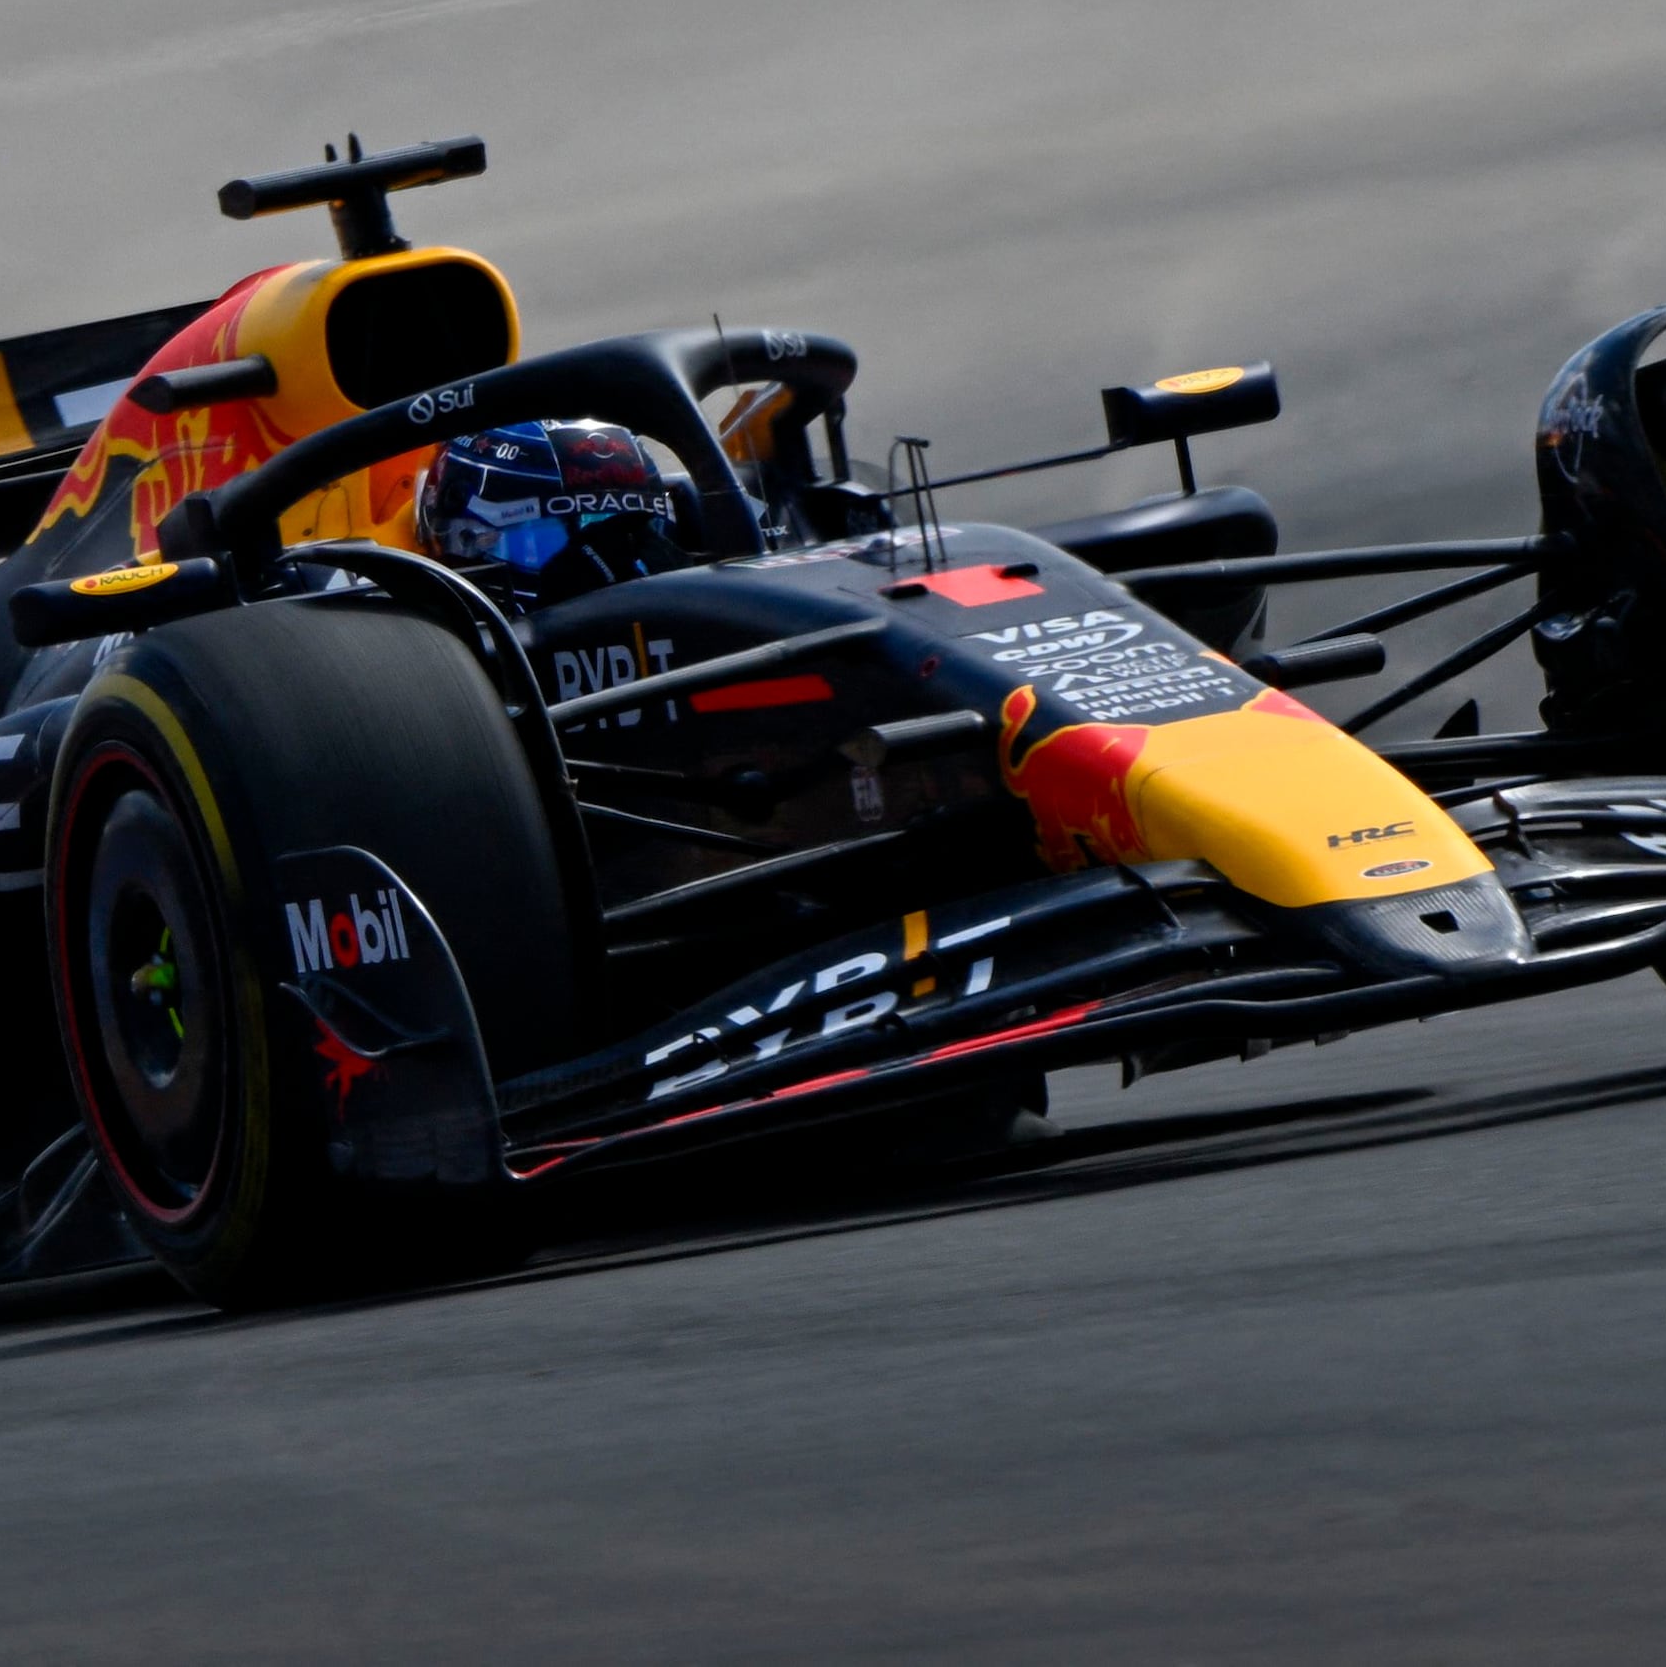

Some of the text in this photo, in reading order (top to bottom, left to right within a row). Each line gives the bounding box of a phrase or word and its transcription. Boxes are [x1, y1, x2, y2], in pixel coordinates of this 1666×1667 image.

[546, 492, 668, 516] ORACLE
[100, 567, 163, 586] RAUCH
[977, 609, 1125, 645] VISA
[992, 632, 1107, 662] CDW
[1089, 691, 1205, 721] Mobil
[1327, 820, 1416, 848] HRC
[284, 888, 411, 974] Mobil
